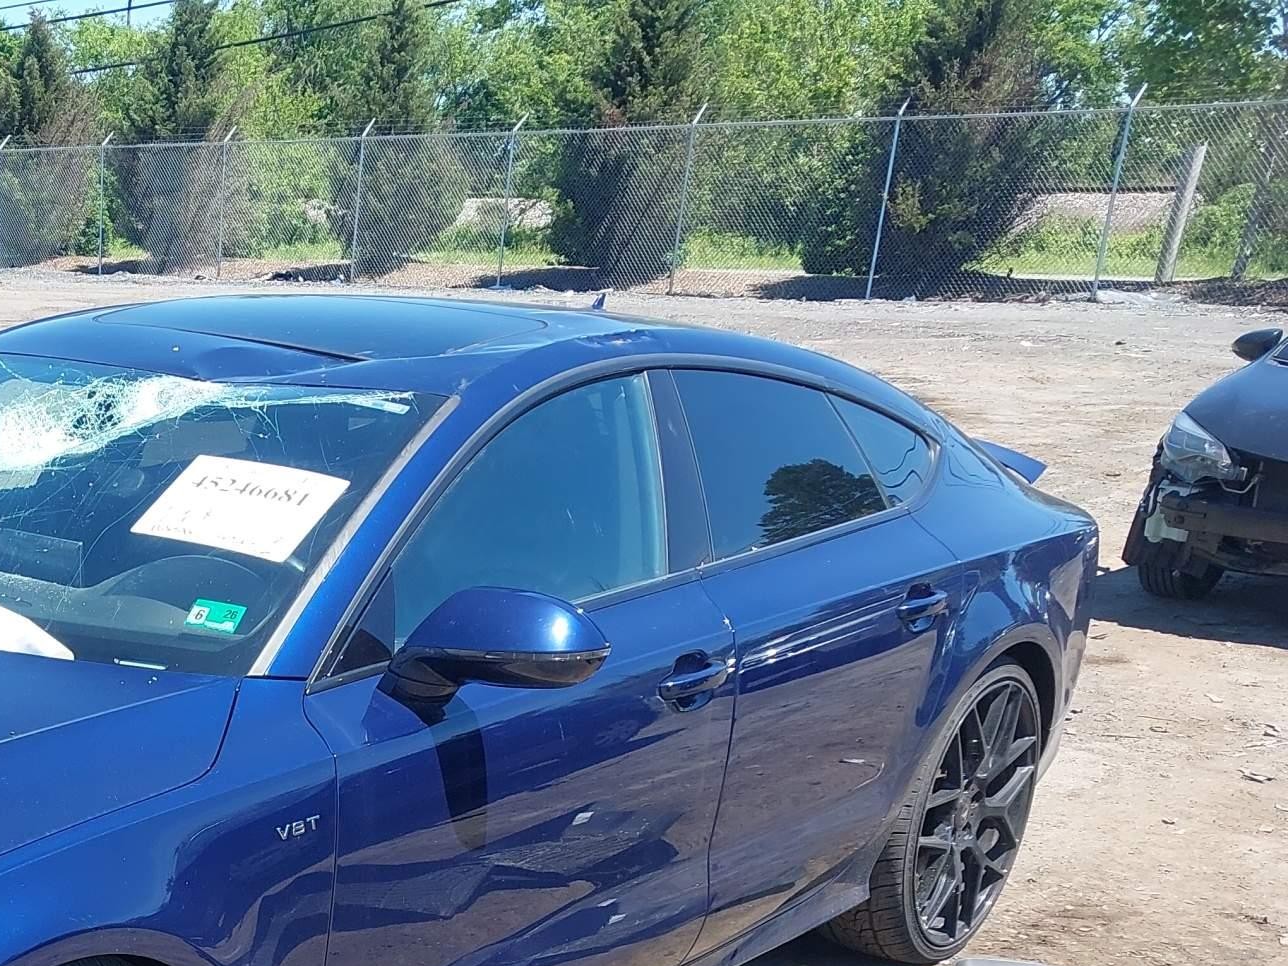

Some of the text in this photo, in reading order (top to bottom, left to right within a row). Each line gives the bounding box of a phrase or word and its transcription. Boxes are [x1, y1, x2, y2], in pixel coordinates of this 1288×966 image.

[192, 475, 310, 506] 45246681
[194, 609, 206, 621] 6
[222, 609, 239, 620] 26
